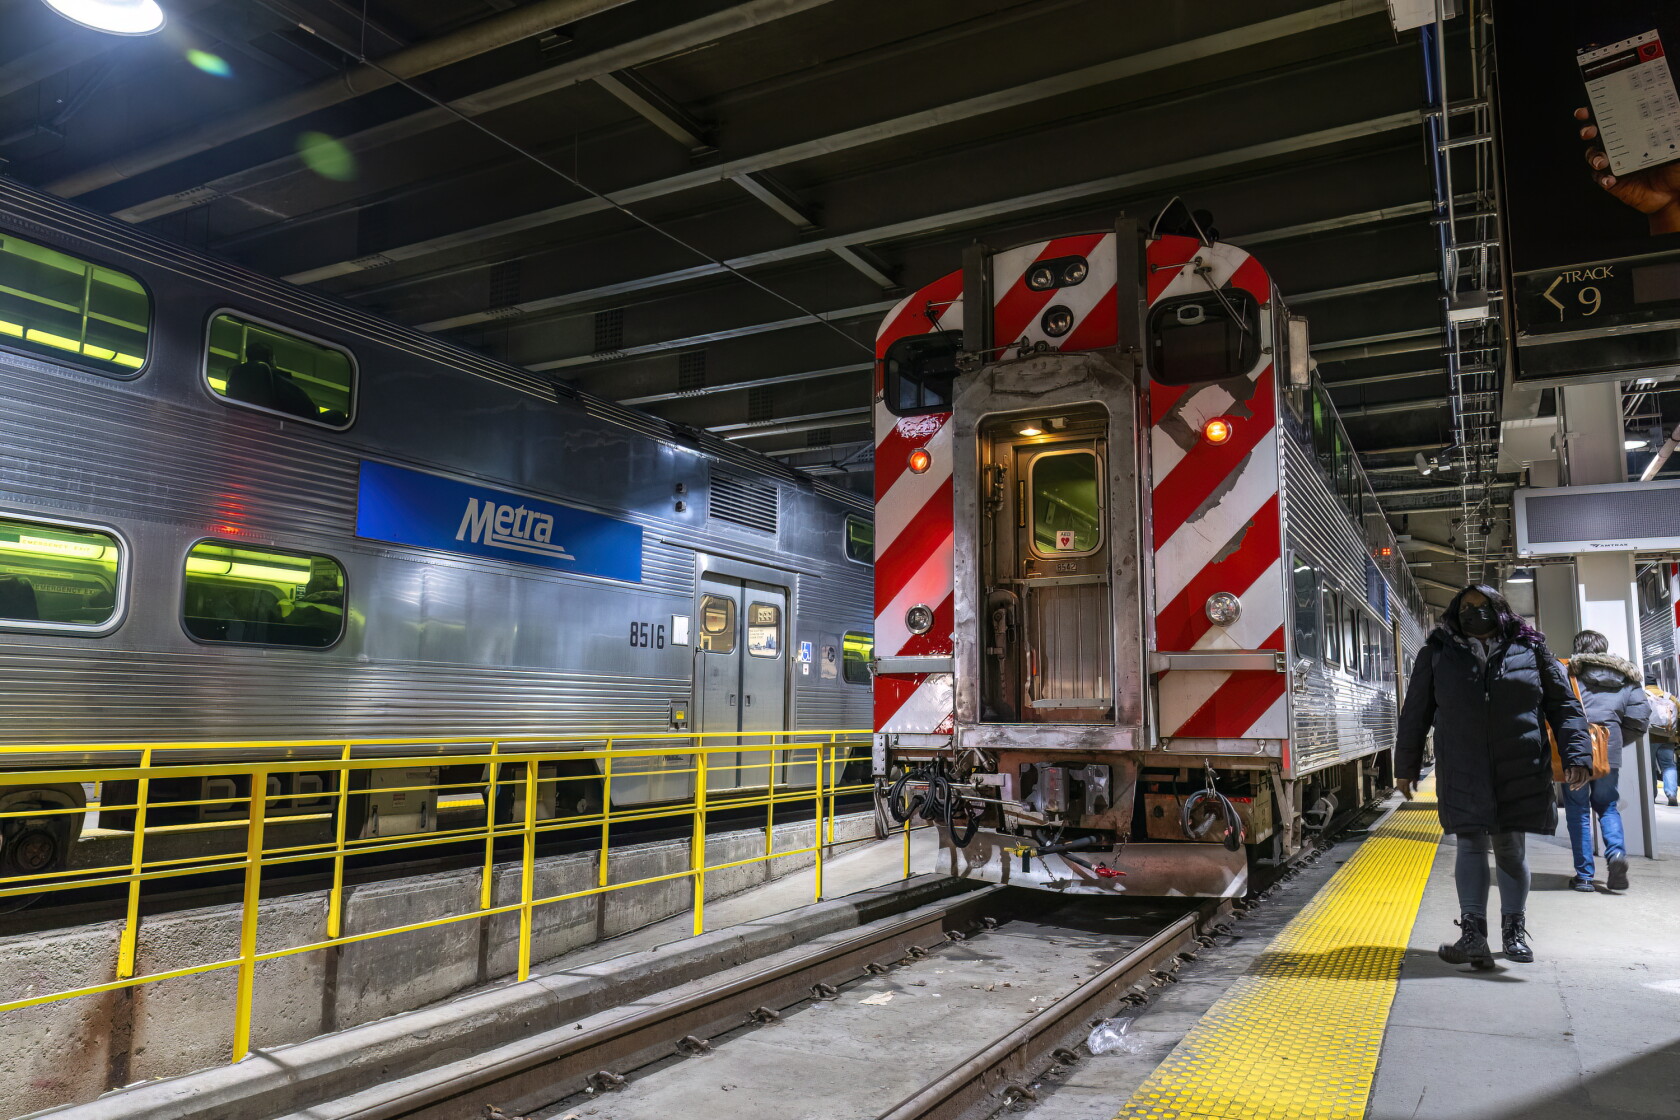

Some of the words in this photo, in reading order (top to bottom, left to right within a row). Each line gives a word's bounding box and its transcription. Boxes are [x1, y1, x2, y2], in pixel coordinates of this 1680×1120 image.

[1562, 265, 1614, 283] TRACK
[1578, 286, 1602, 316] 9
[455, 497, 556, 548] Metra
[630, 621, 665, 650] 8516
